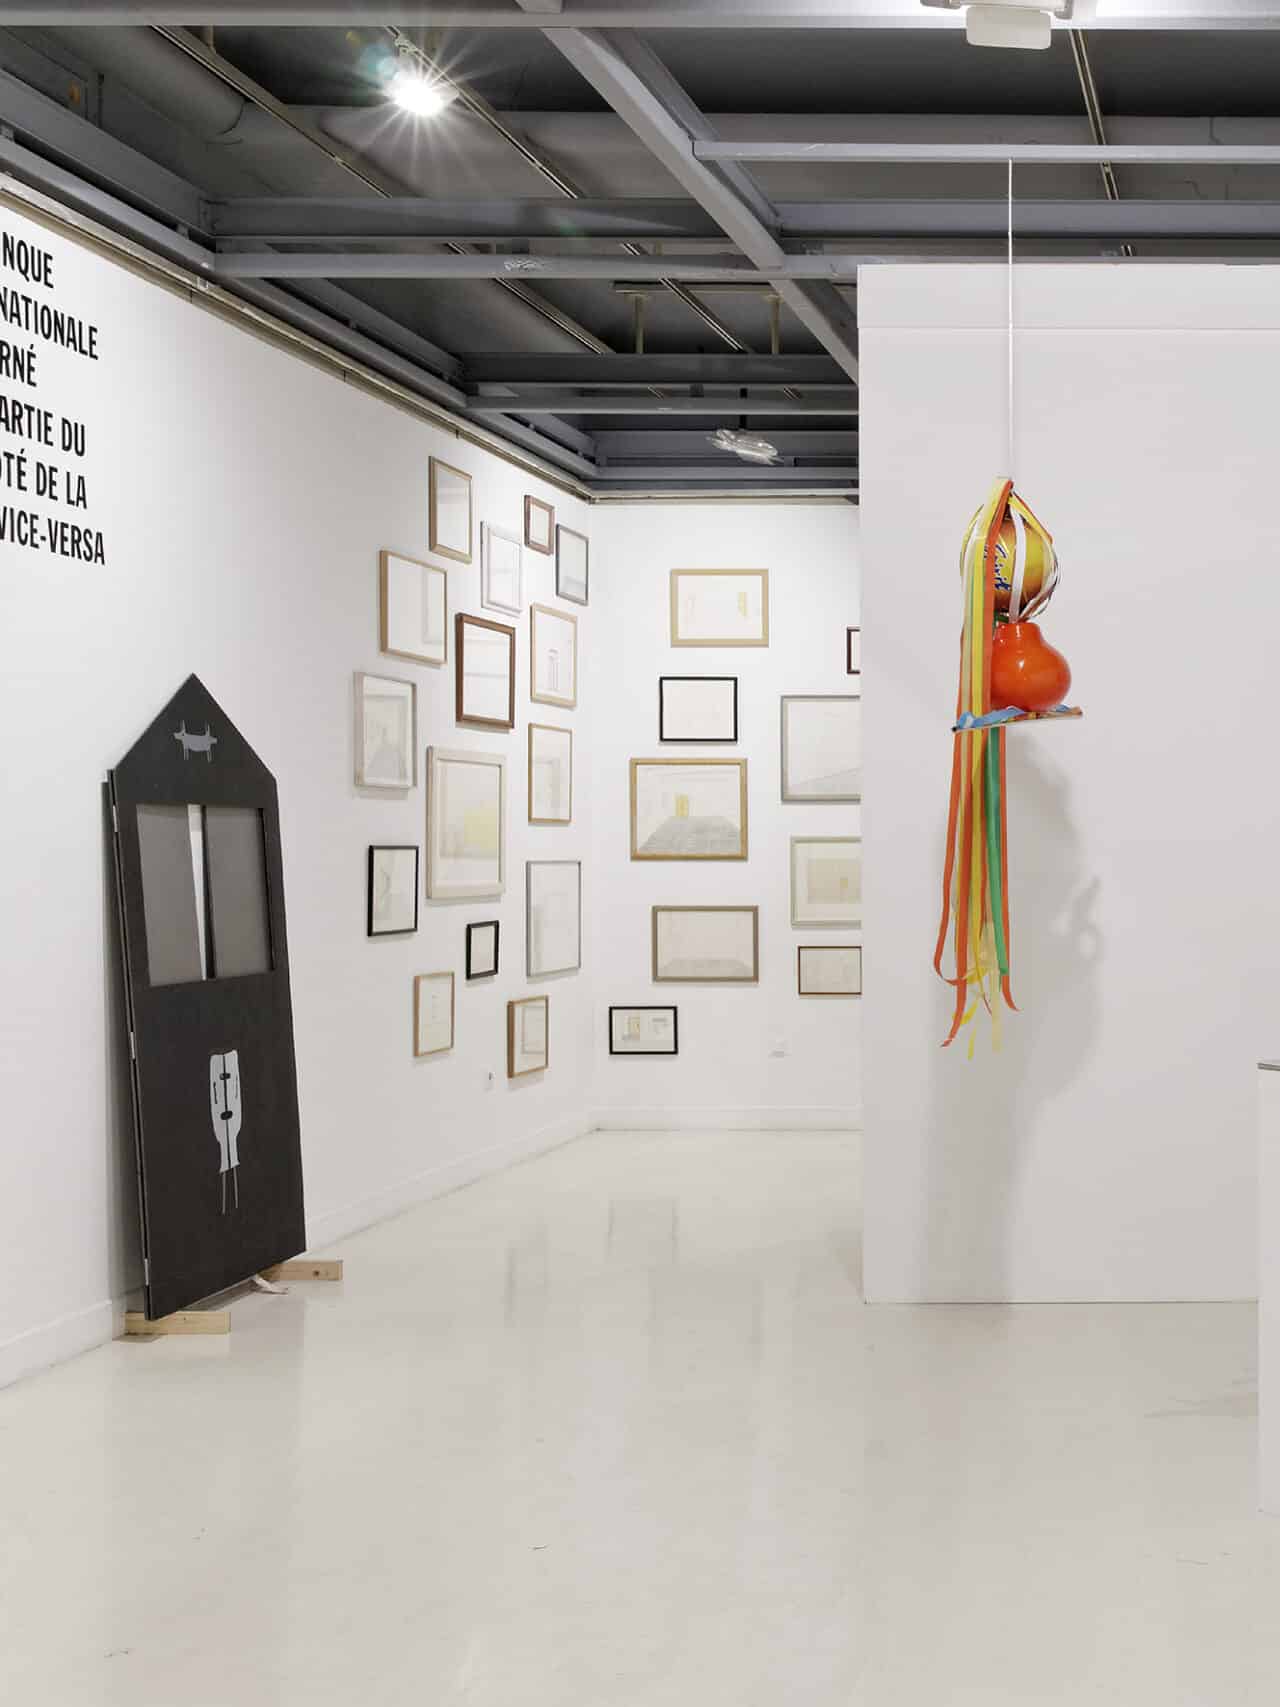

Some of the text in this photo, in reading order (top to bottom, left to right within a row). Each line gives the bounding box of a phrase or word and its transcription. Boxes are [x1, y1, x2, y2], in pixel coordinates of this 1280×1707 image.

[3, 232, 54, 289] NQUE
[0, 286, 98, 360] NATIONALE
[0, 340, 37, 387] RNÉ
[0, 395, 85, 456] ARTIE DU
[0, 448, 87, 509] TÉ DE LA
[0, 506, 105, 565] VICE-VERSA
